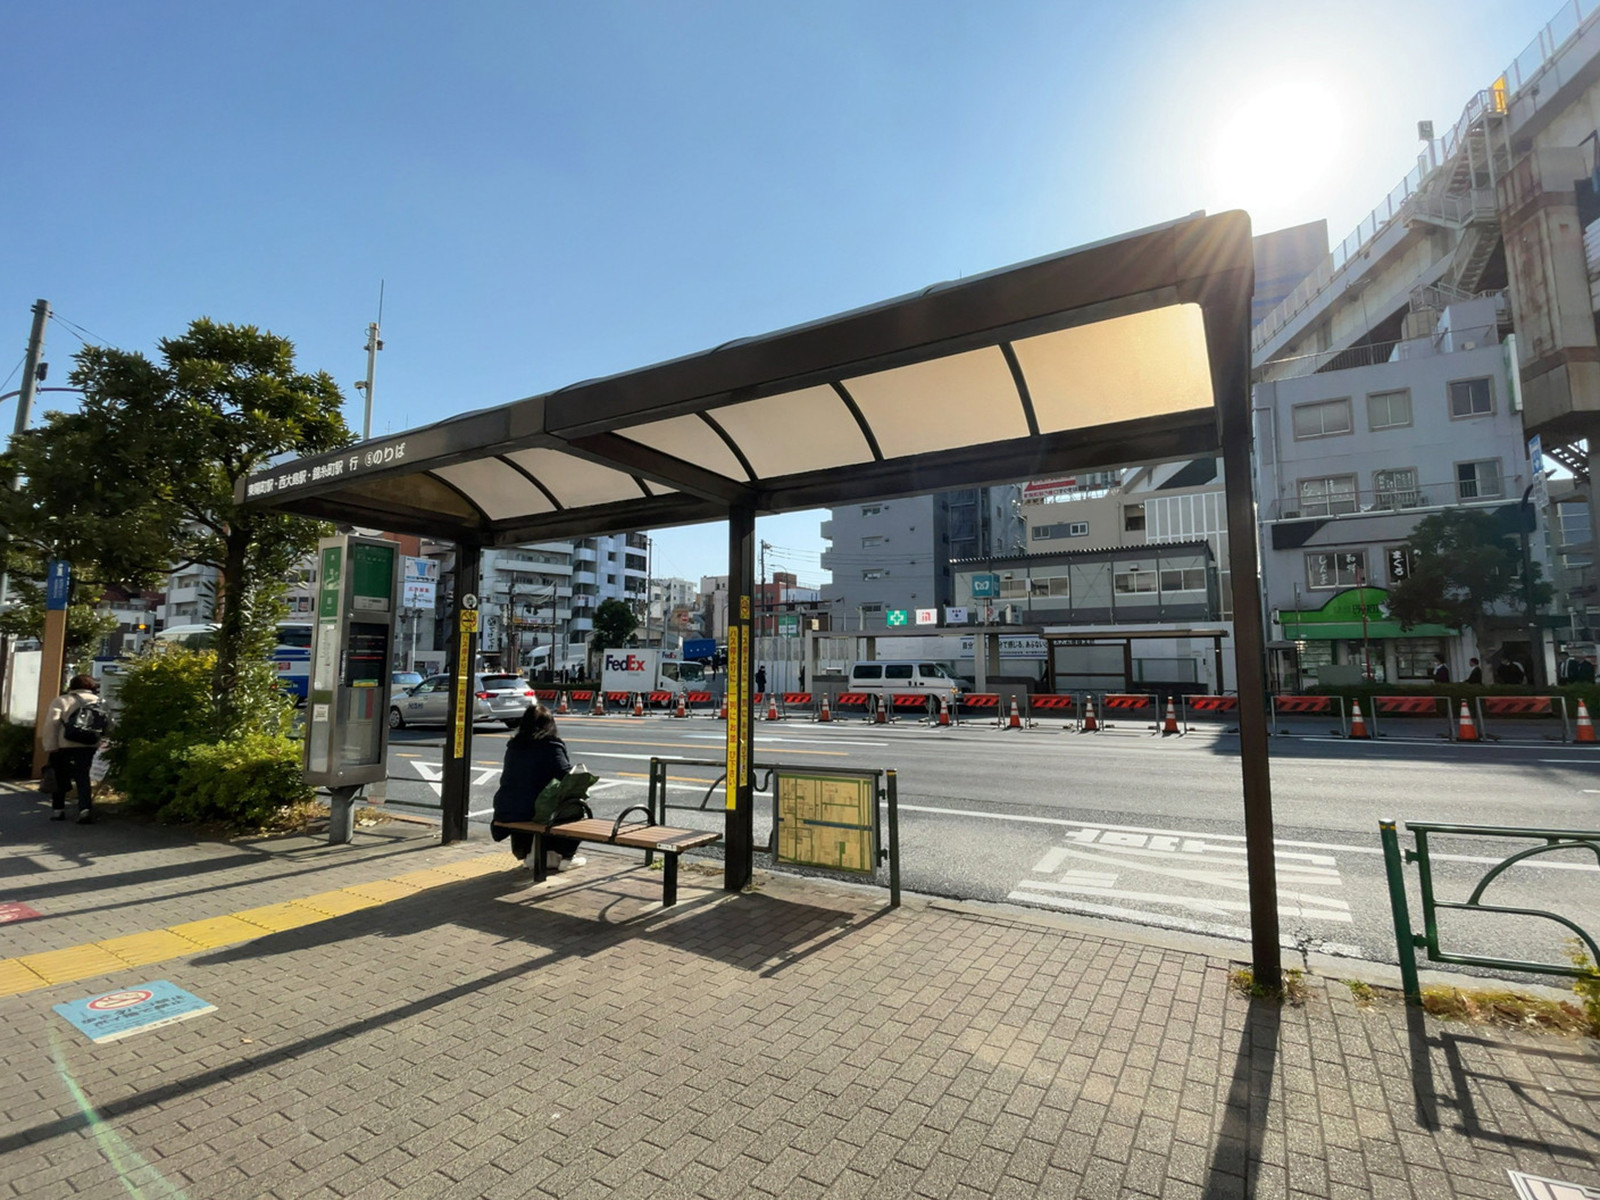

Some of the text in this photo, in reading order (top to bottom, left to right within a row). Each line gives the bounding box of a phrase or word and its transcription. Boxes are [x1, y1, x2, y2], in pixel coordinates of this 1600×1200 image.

[349, 455, 359, 472] 行
[1392, 550, 1404, 576] まぐろ
[605, 654, 646, 672] FedEx
[661, 651, 677, 659] FedEx
